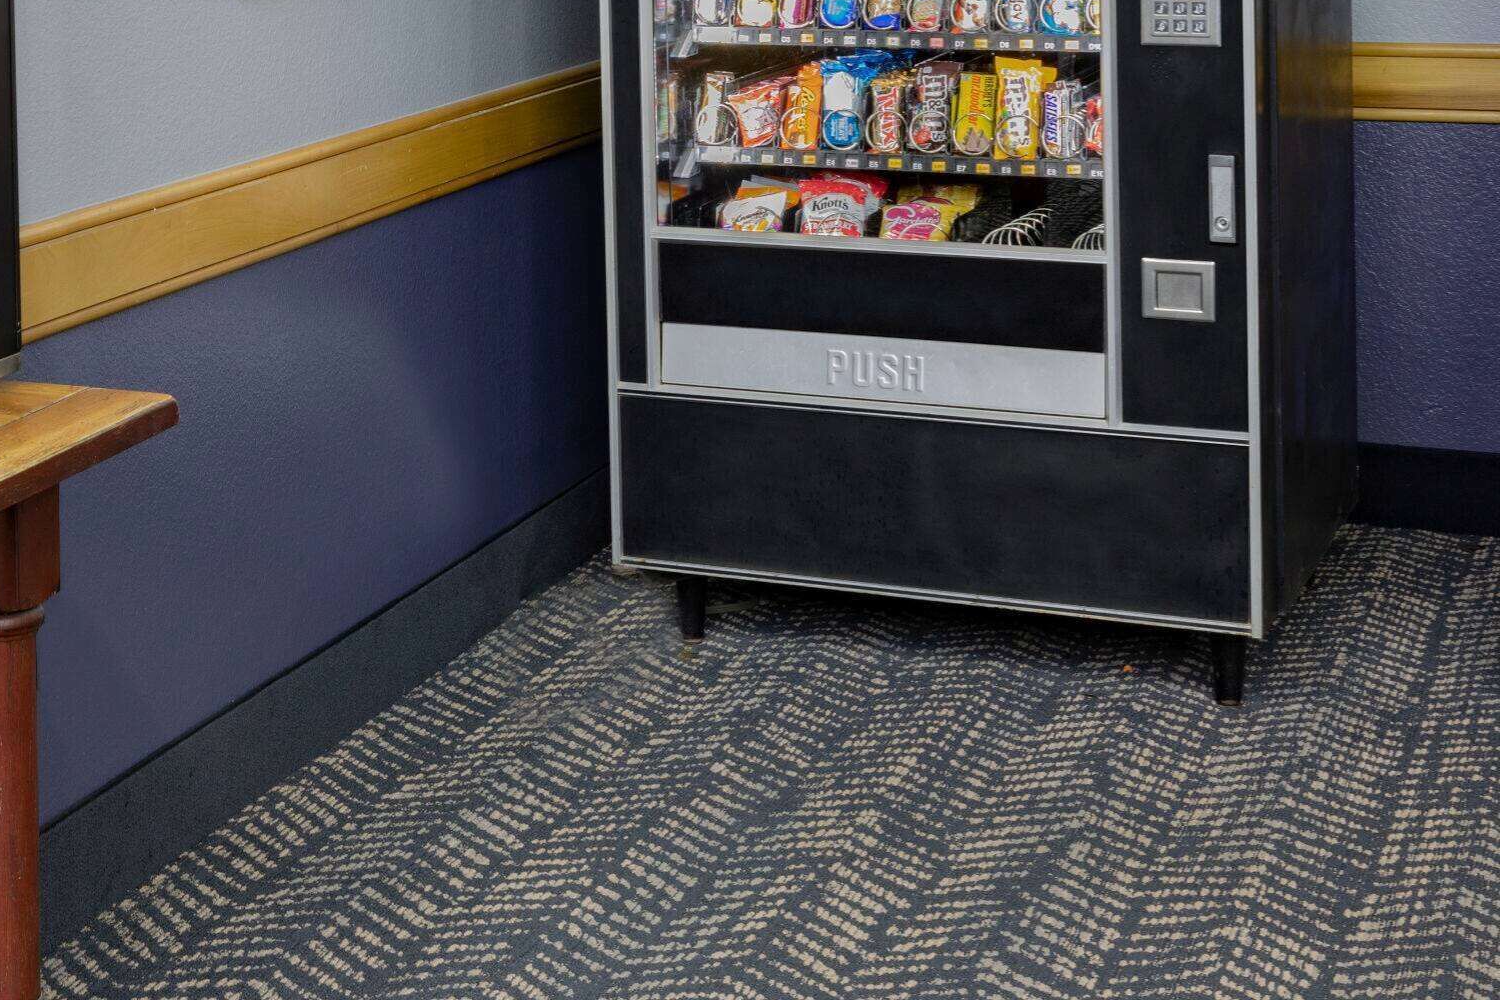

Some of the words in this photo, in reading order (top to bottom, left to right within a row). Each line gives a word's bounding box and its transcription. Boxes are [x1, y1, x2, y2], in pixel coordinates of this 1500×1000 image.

[1045, 92, 1059, 144] SATISFIES
[956, 164, 967, 172] E7
[812, 196, 849, 212] Knott's
[826, 349, 925, 393] PUSH
